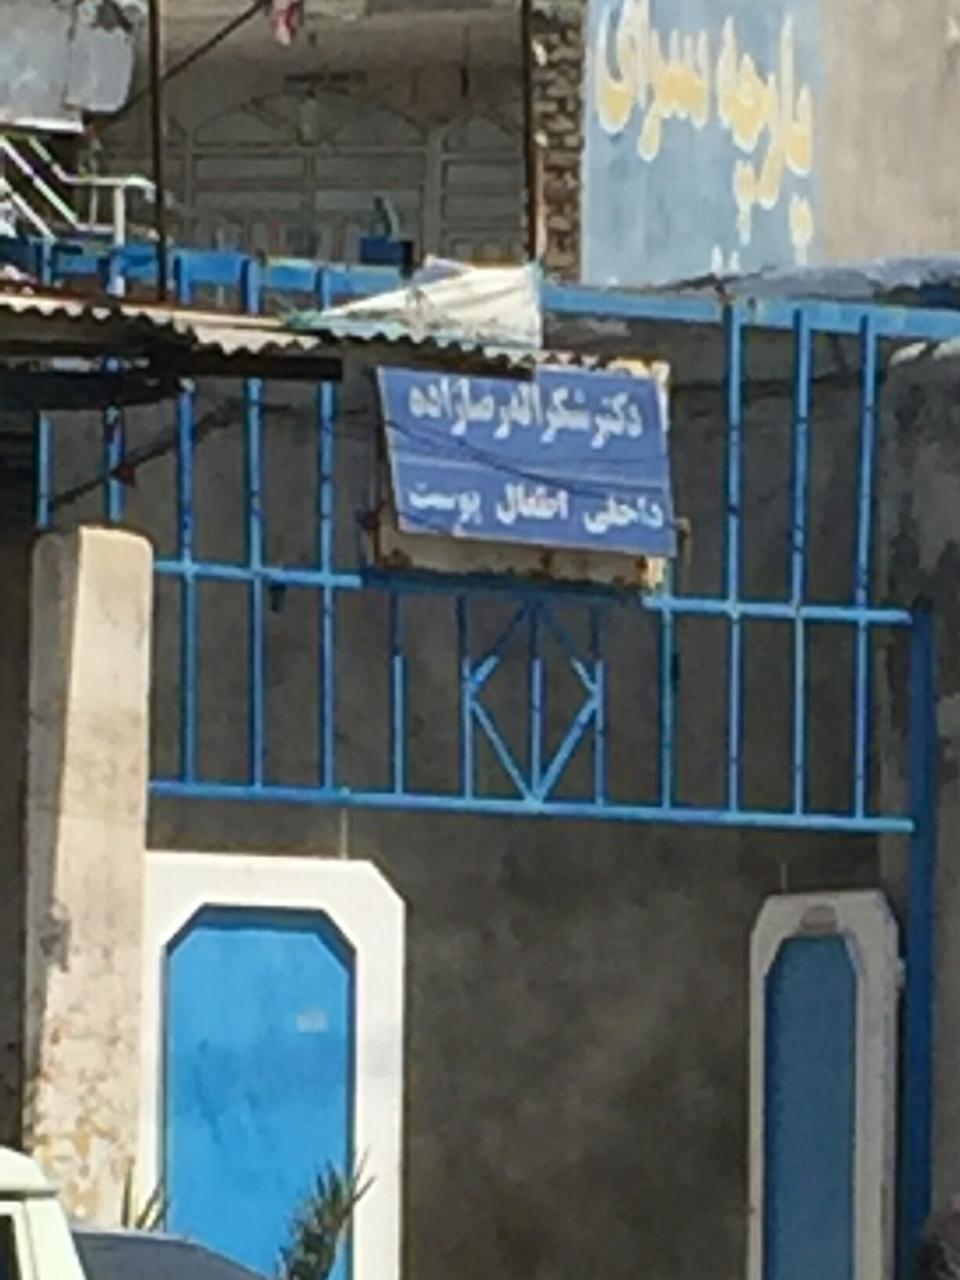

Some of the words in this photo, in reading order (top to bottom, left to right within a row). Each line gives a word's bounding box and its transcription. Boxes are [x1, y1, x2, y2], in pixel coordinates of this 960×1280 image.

[591, 392, 643, 448] دکتر
[497, 483, 569, 525] اطفال
[584, 496, 664, 533] داخلی
